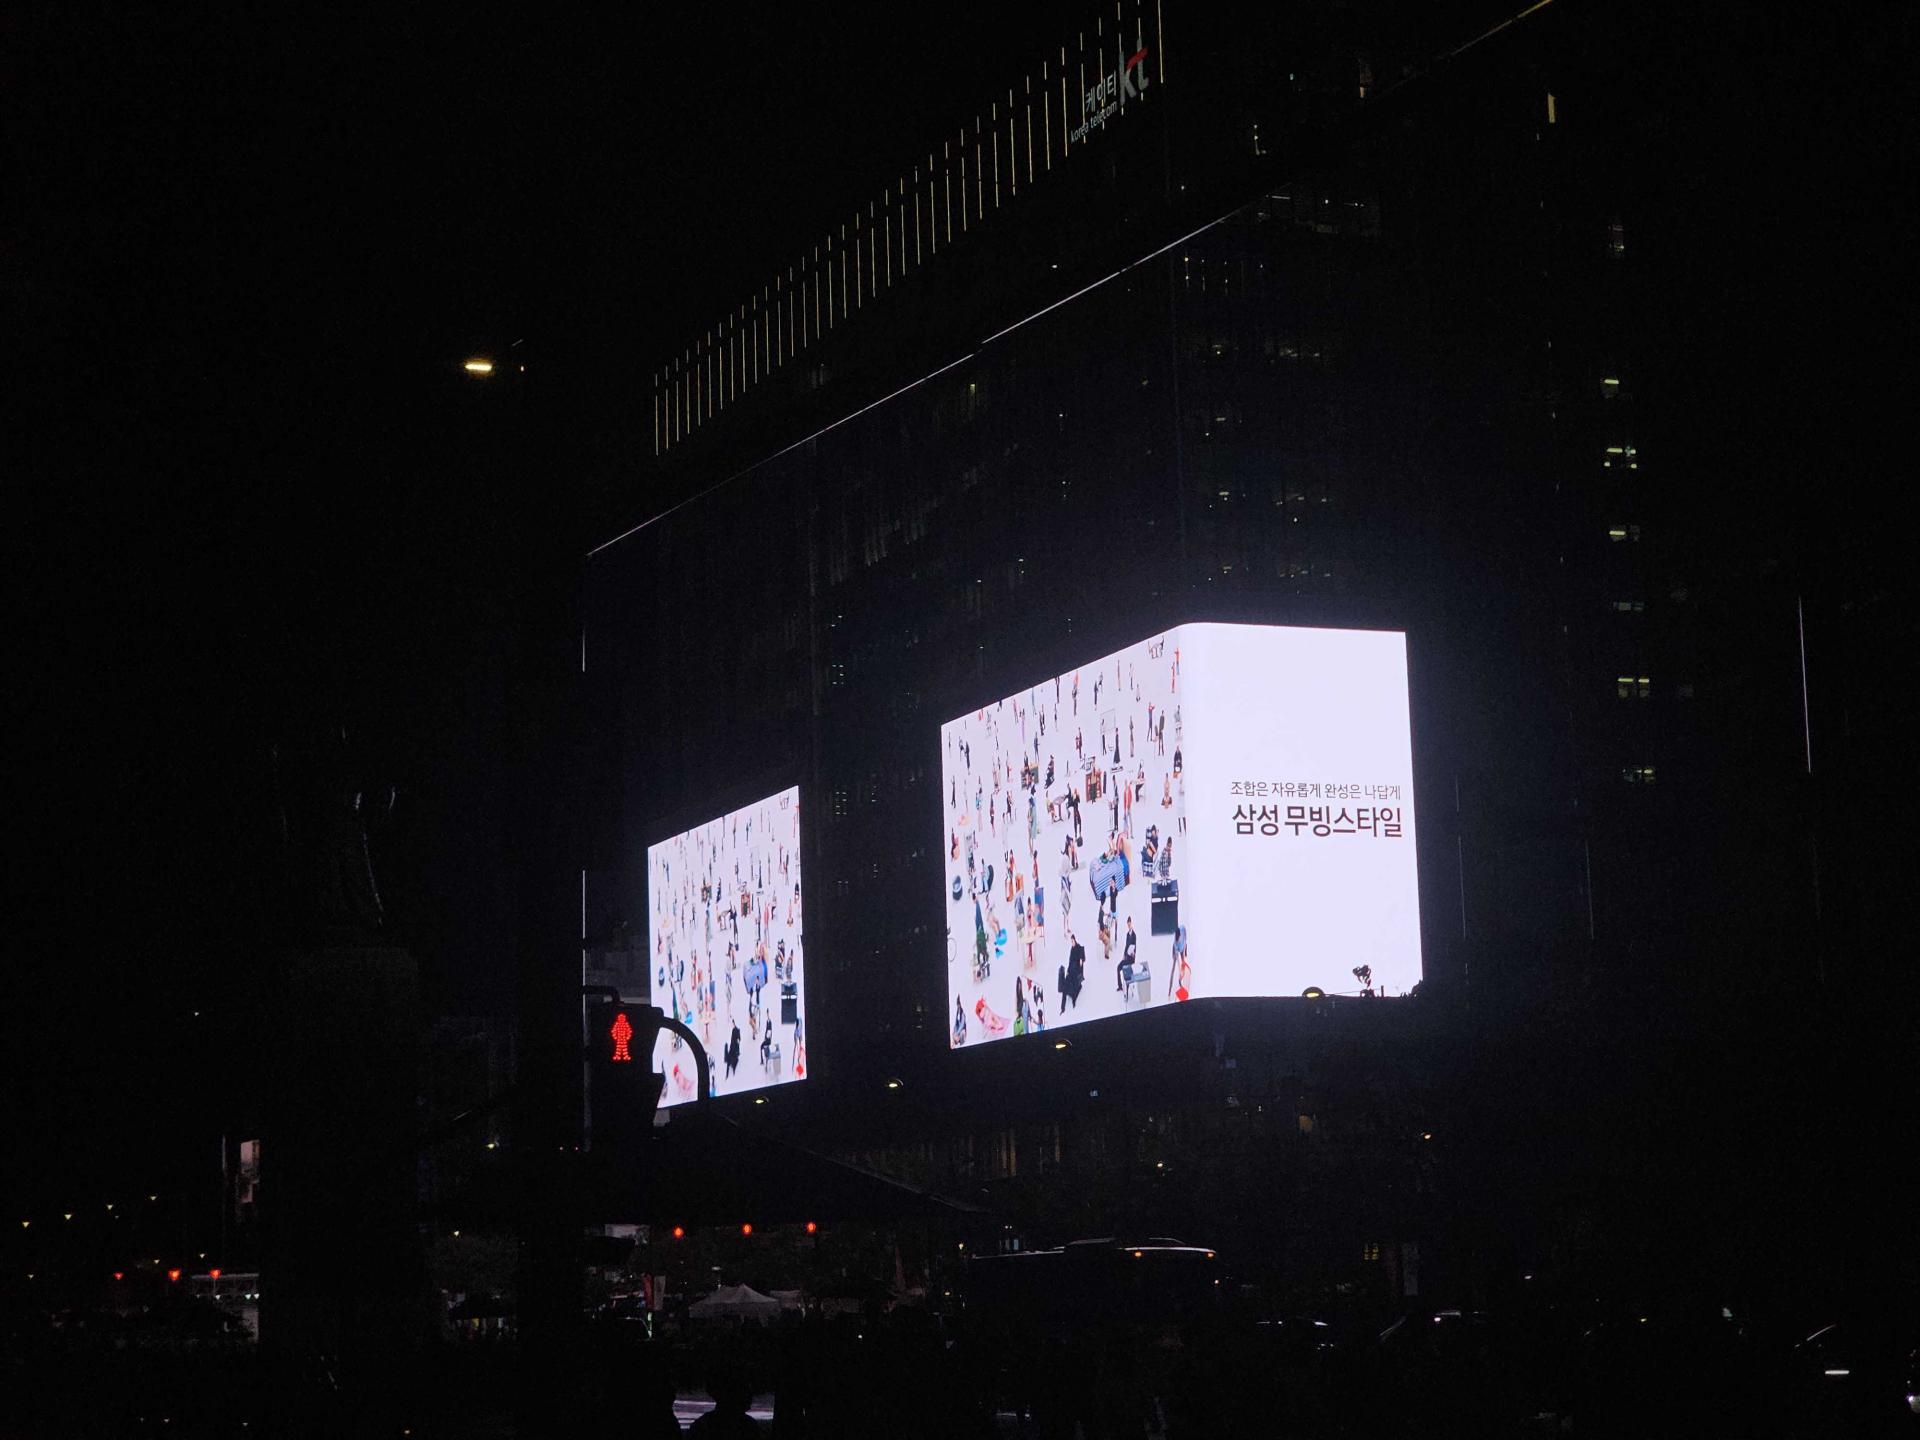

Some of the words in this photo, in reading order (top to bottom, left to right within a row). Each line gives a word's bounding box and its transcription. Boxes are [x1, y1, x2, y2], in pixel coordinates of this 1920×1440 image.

[1085, 70, 1117, 112] 케이티
[1070, 121, 1089, 143] korea
[1090, 101, 1118, 129] telecom
[1230, 781, 1269, 797] 조합은
[1271, 782, 1321, 798] 자유롭게
[1324, 783, 1362, 800] 완성은
[1364, 785, 1401, 800] 나답게
[1232, 804, 1280, 837] 삼성
[1284, 805, 1403, 838] 무빙스타일
